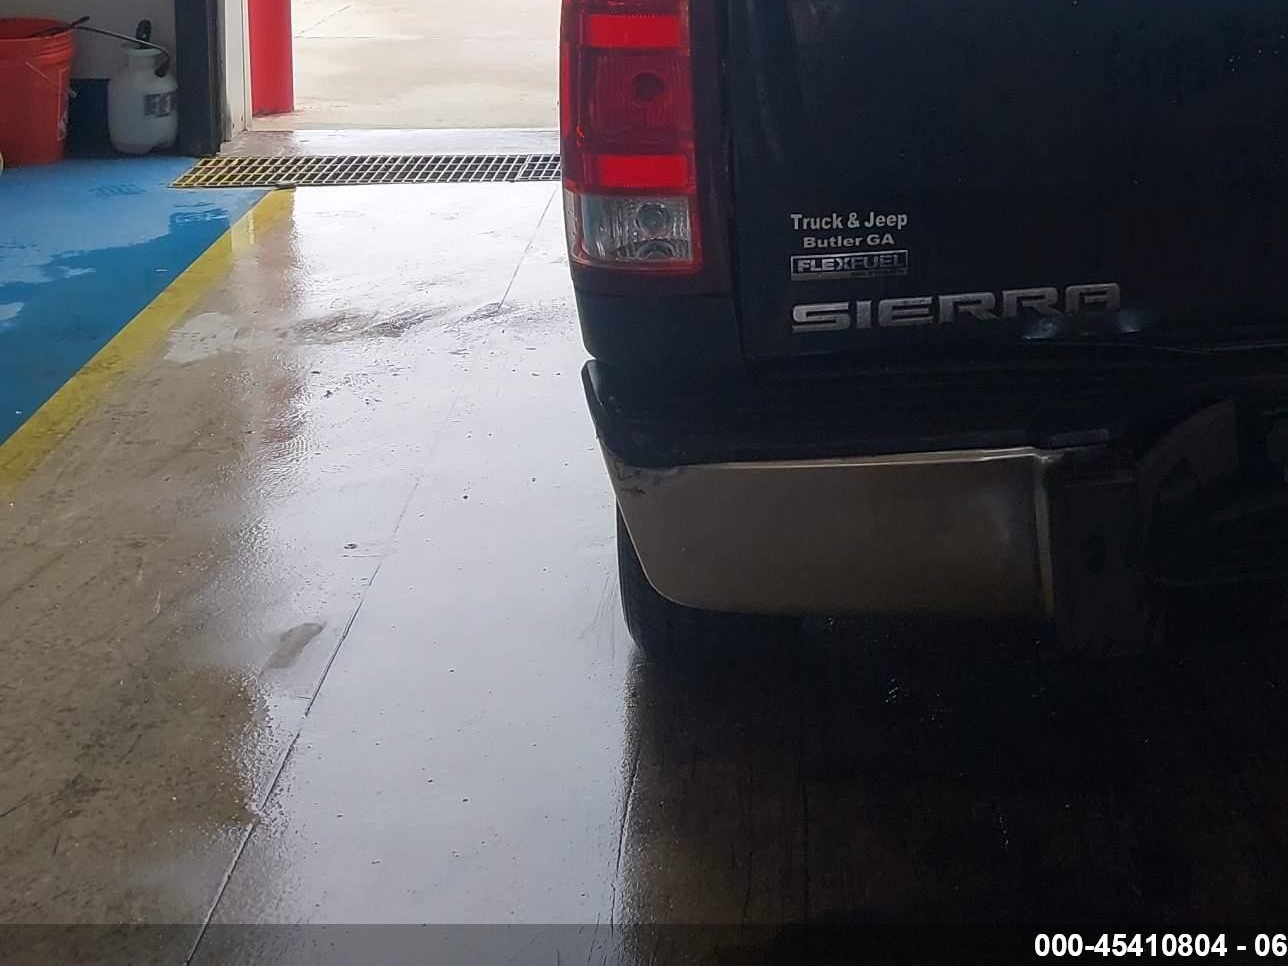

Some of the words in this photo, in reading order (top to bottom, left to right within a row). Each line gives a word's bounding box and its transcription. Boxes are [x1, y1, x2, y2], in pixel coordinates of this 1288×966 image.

[790, 212, 844, 230] Truck
[847, 212, 860, 229] &
[864, 211, 908, 231] Jeep
[803, 235, 863, 249] Butler
[866, 233, 896, 246] GA
[797, 254, 904, 272] FLEXFUEL
[791, 281, 1122, 334] SIERRA
